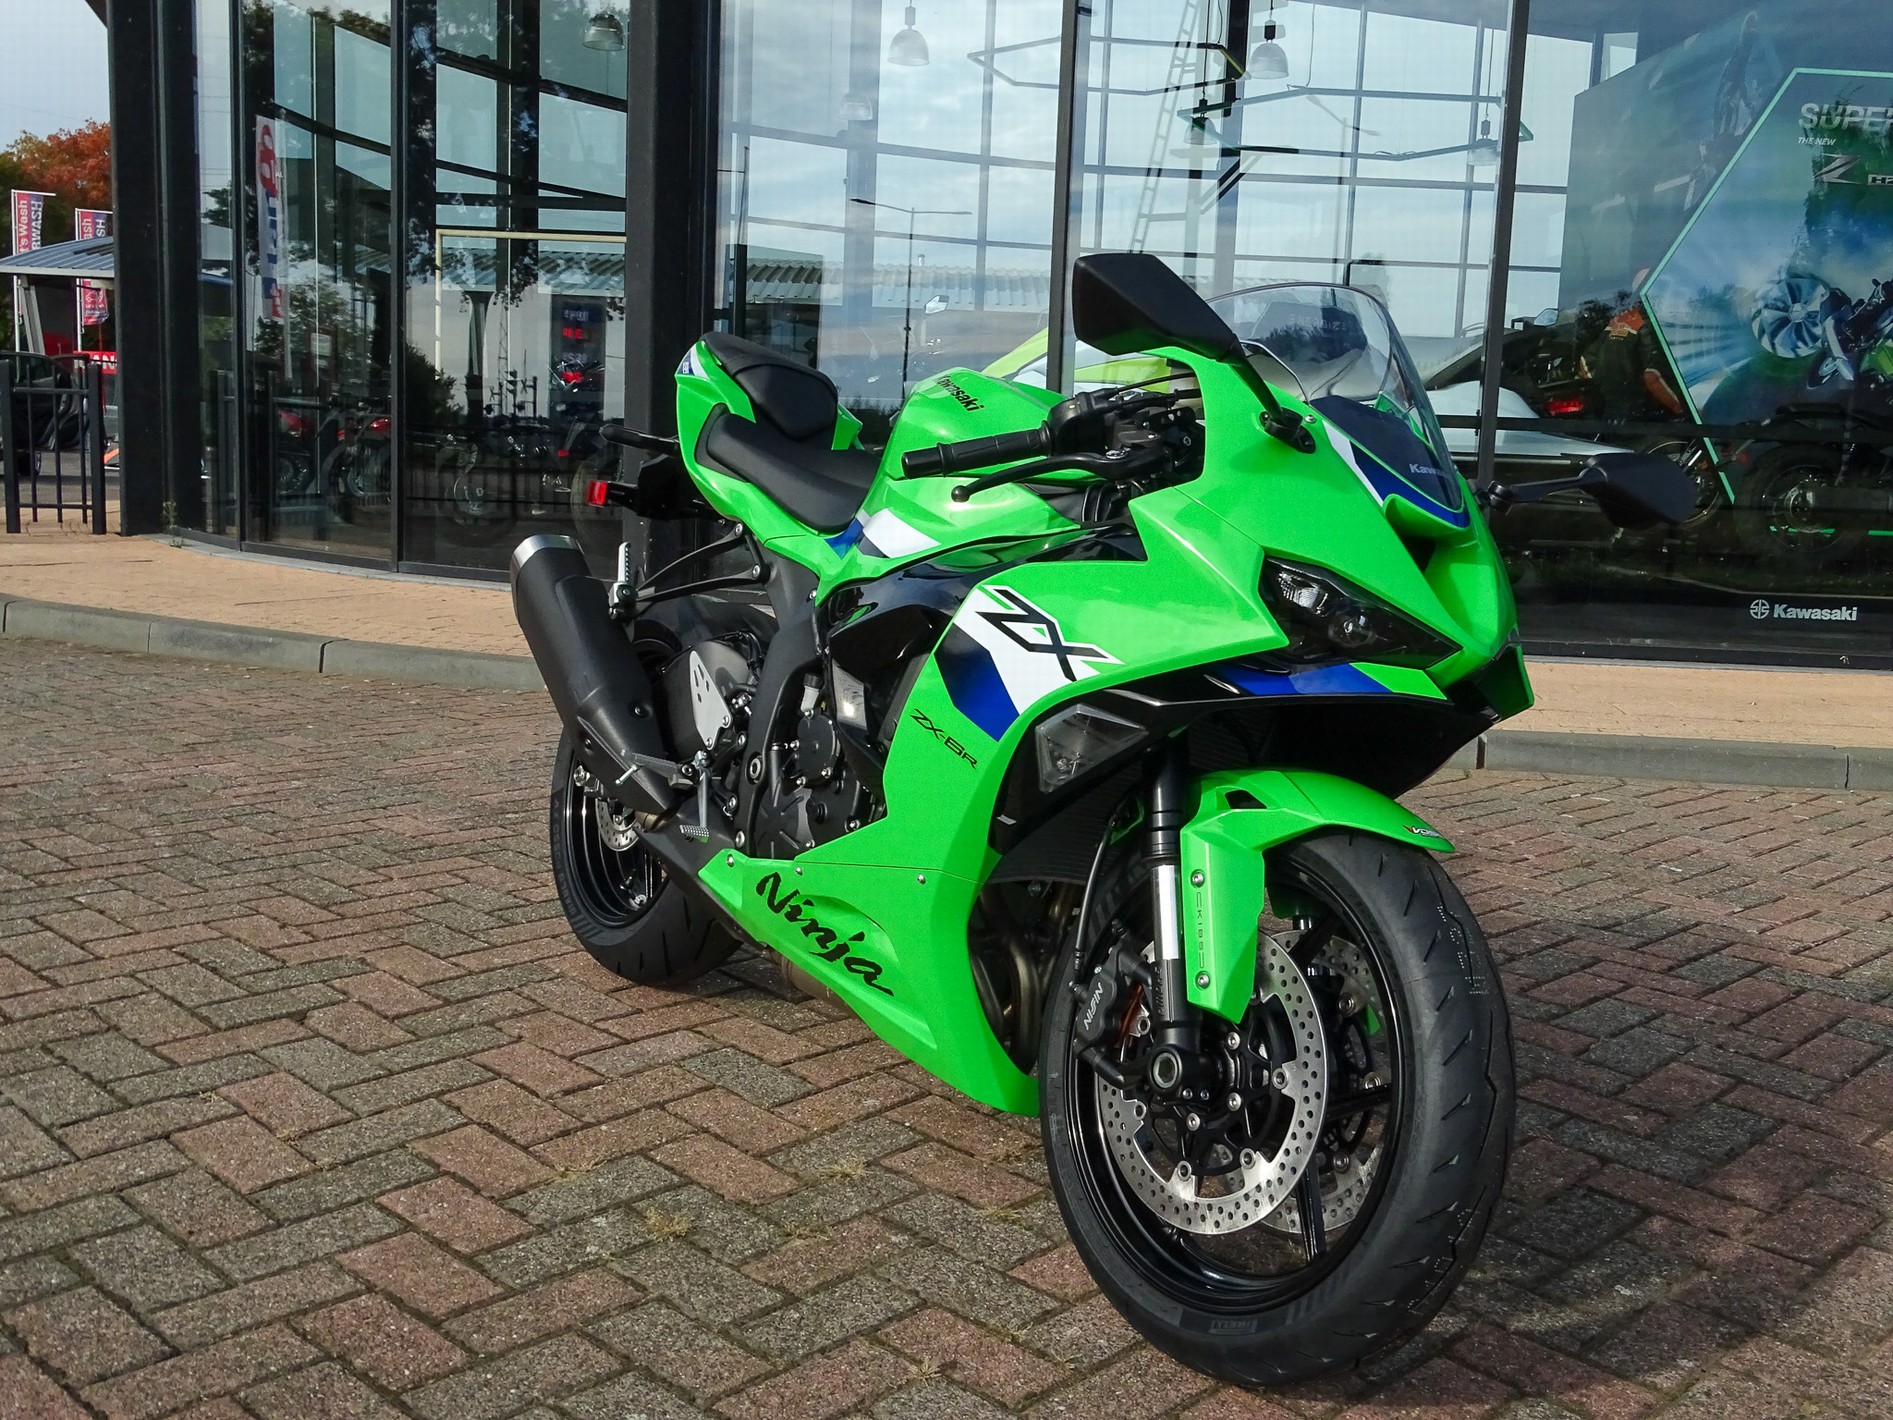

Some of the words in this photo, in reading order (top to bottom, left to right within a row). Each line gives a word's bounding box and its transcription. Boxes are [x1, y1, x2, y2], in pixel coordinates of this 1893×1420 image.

[1798, 137, 1814, 145] THE
[1815, 138, 1836, 146] NEW
[18, 199, 28, 234] Wash
[31, 200, 43, 250] RWASH
[83, 218, 92, 240] ash
[1773, 604, 1858, 620] Kawasaki
[975, 588, 1109, 682] ZX
[910, 708, 978, 769] ZX-6R
[755, 871, 895, 997] Ninja
